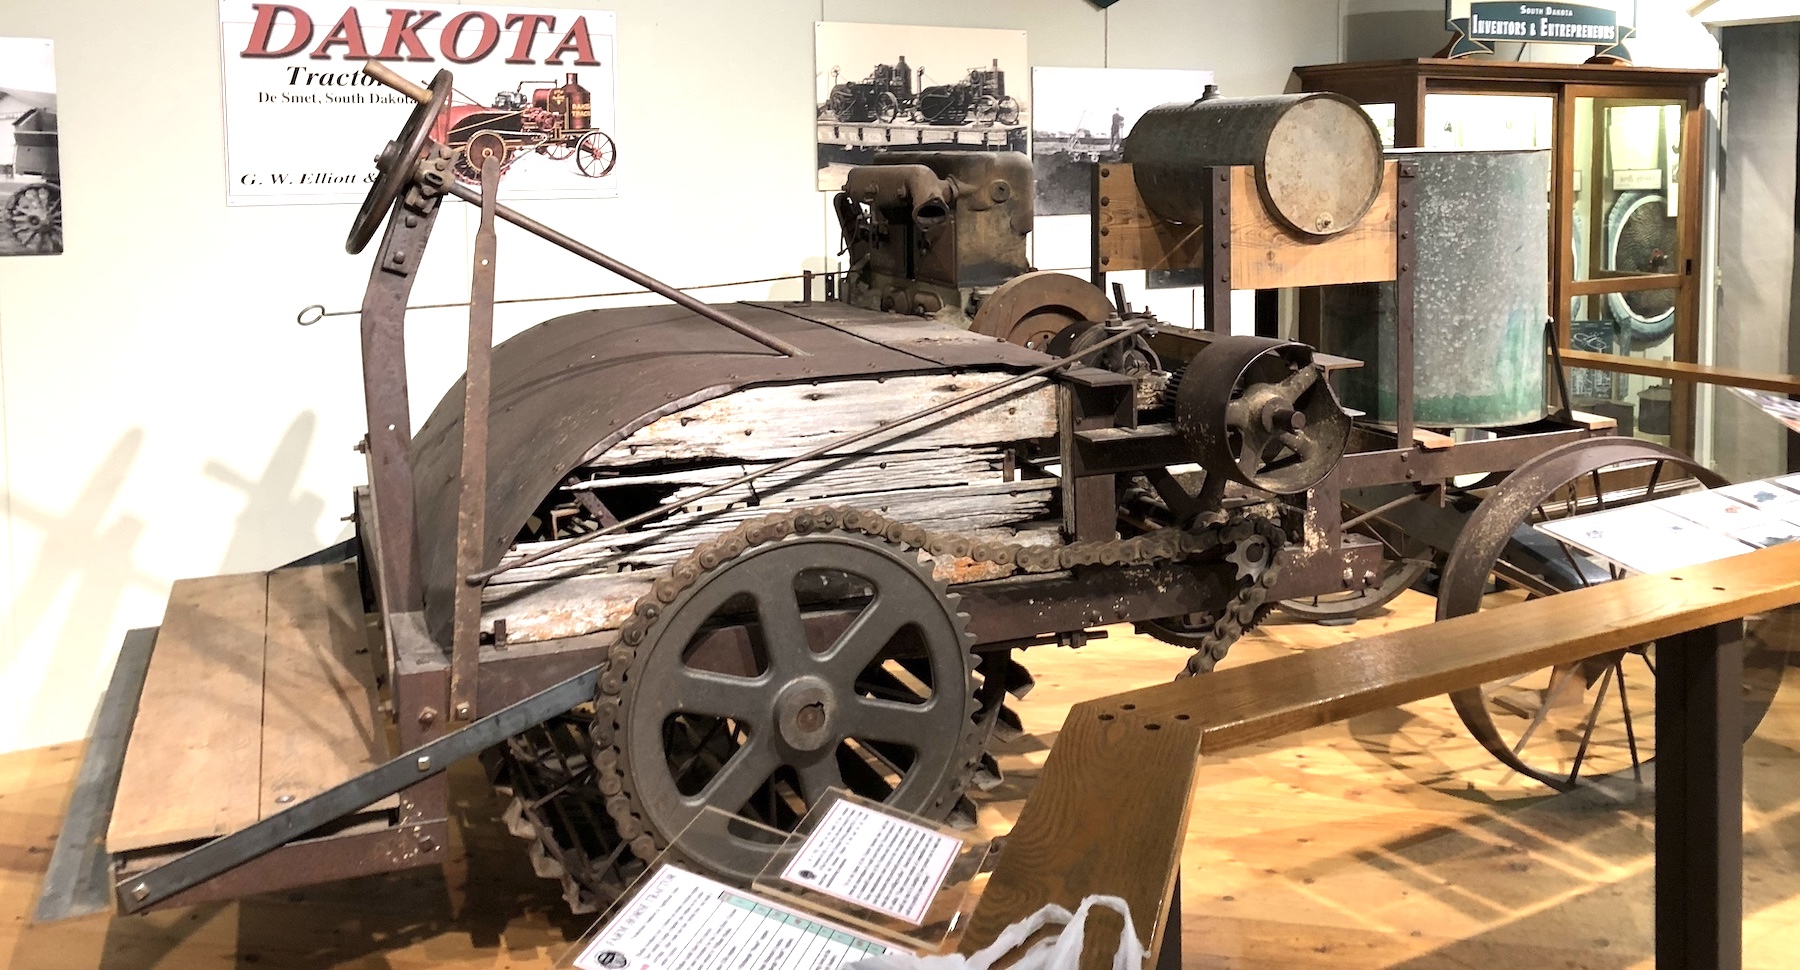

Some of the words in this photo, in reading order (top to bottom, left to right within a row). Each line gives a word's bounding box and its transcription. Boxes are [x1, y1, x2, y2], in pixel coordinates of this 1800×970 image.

[1520, 5, 1543, 15] SOUTH
[1545, 6, 1574, 16] DAKOTA
[1472, 14, 1527, 37] INVENTORS
[1529, 22, 1537, 37] &
[1540, 17, 1616, 40] ENTREPRENEURS
[240, 3, 601, 67] DAKOTA
[258, 92, 277, 104] De
[281, 92, 322, 105] Smet,
[325, 92, 365, 104] South
[240, 173, 263, 186] G.
[271, 173, 293, 185] W.
[299, 172, 357, 185] Elliott
[363, 172, 377, 184] &
